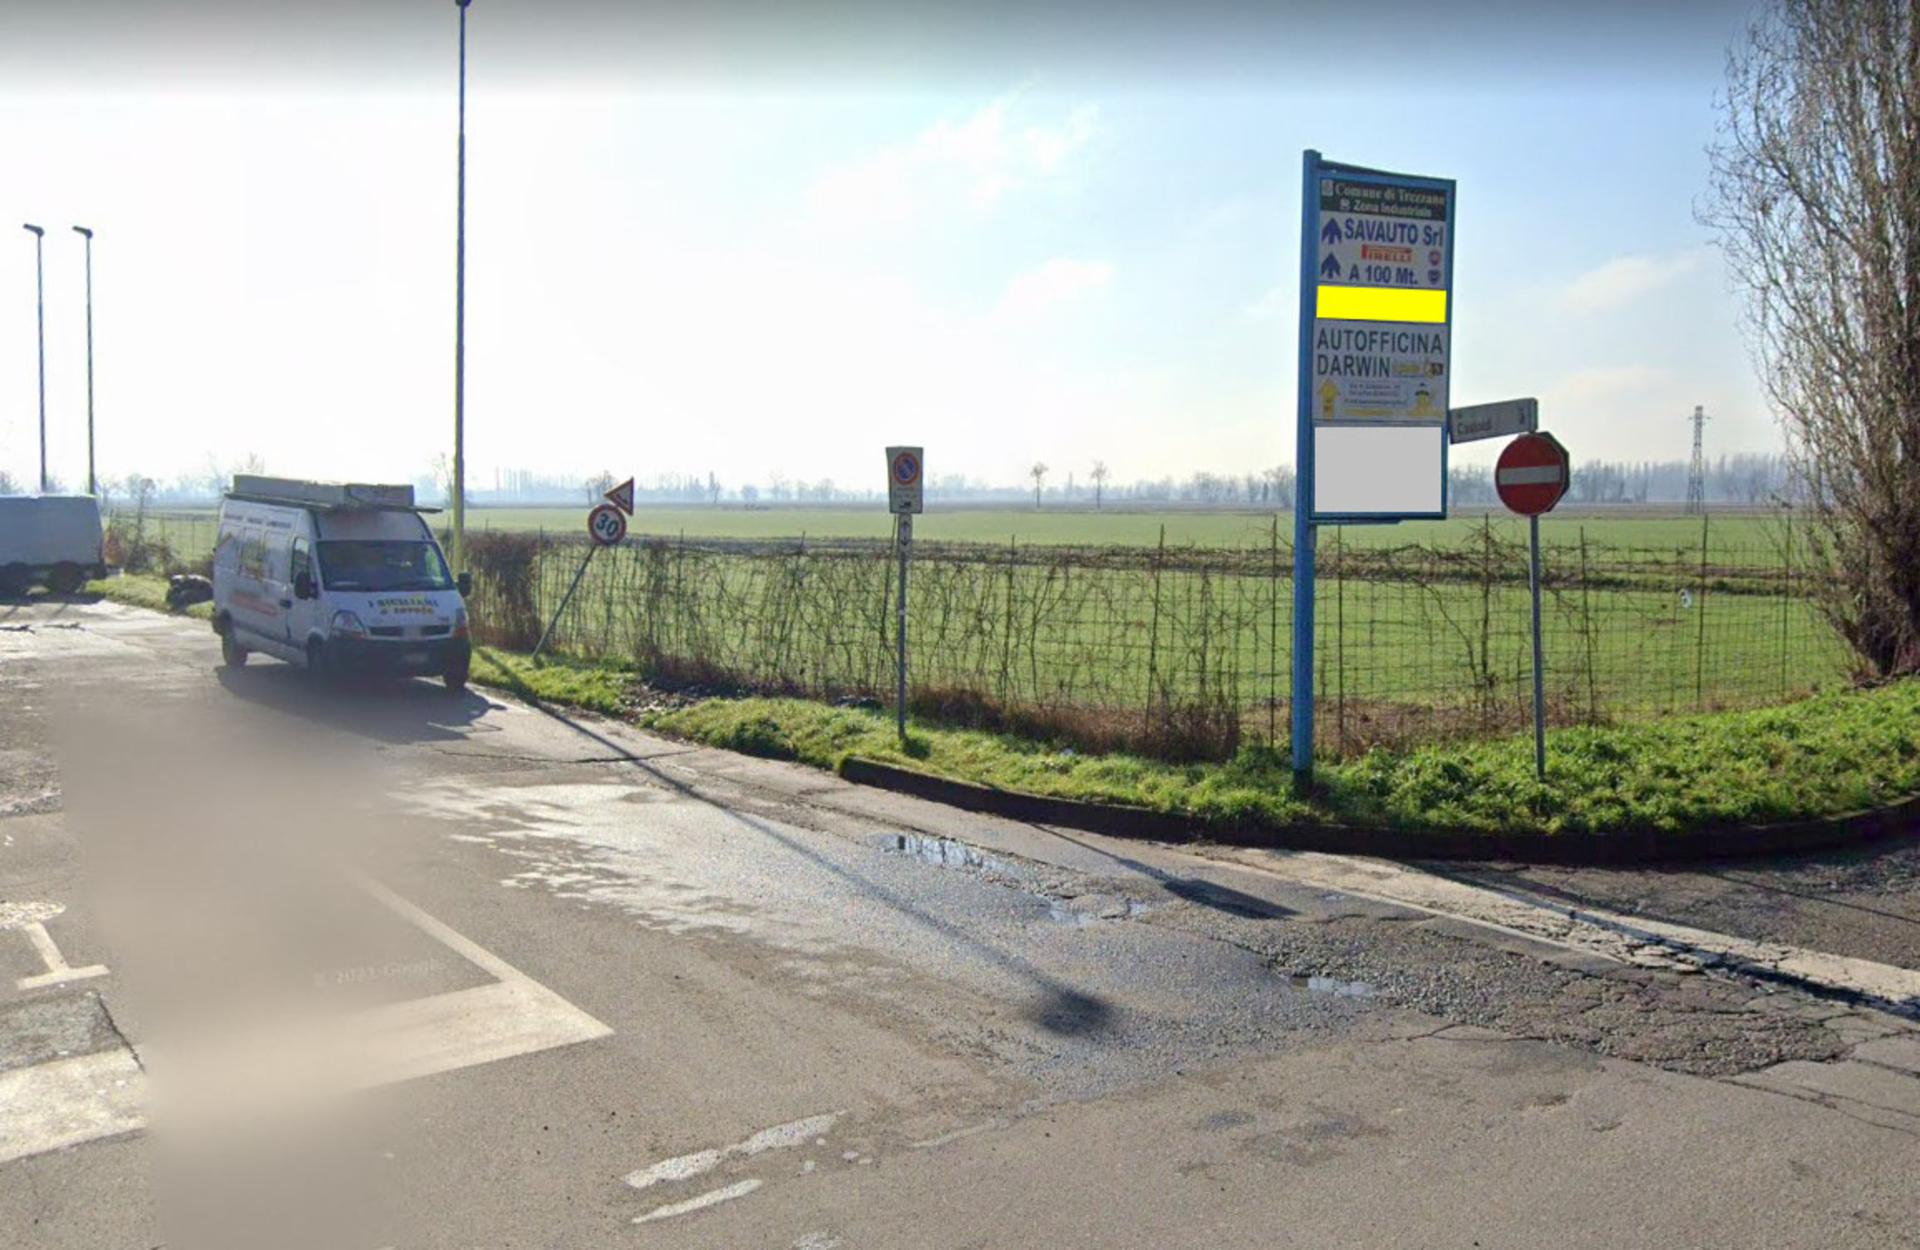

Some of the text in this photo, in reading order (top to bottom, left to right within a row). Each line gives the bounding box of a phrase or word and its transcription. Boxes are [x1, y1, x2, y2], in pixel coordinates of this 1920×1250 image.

[1335, 182, 1382, 200] Comune
[1384, 186, 1395, 201] di
[1353, 199, 1379, 213] Zona
[1344, 218, 1444, 246] SAVAUTO Srl
[1349, 264, 1418, 285] A 100 Mt.
[1317, 327, 1444, 354] AUTOFFICINA
[1317, 354, 1391, 378] DARWIN
[596, 513, 619, 536] 30
